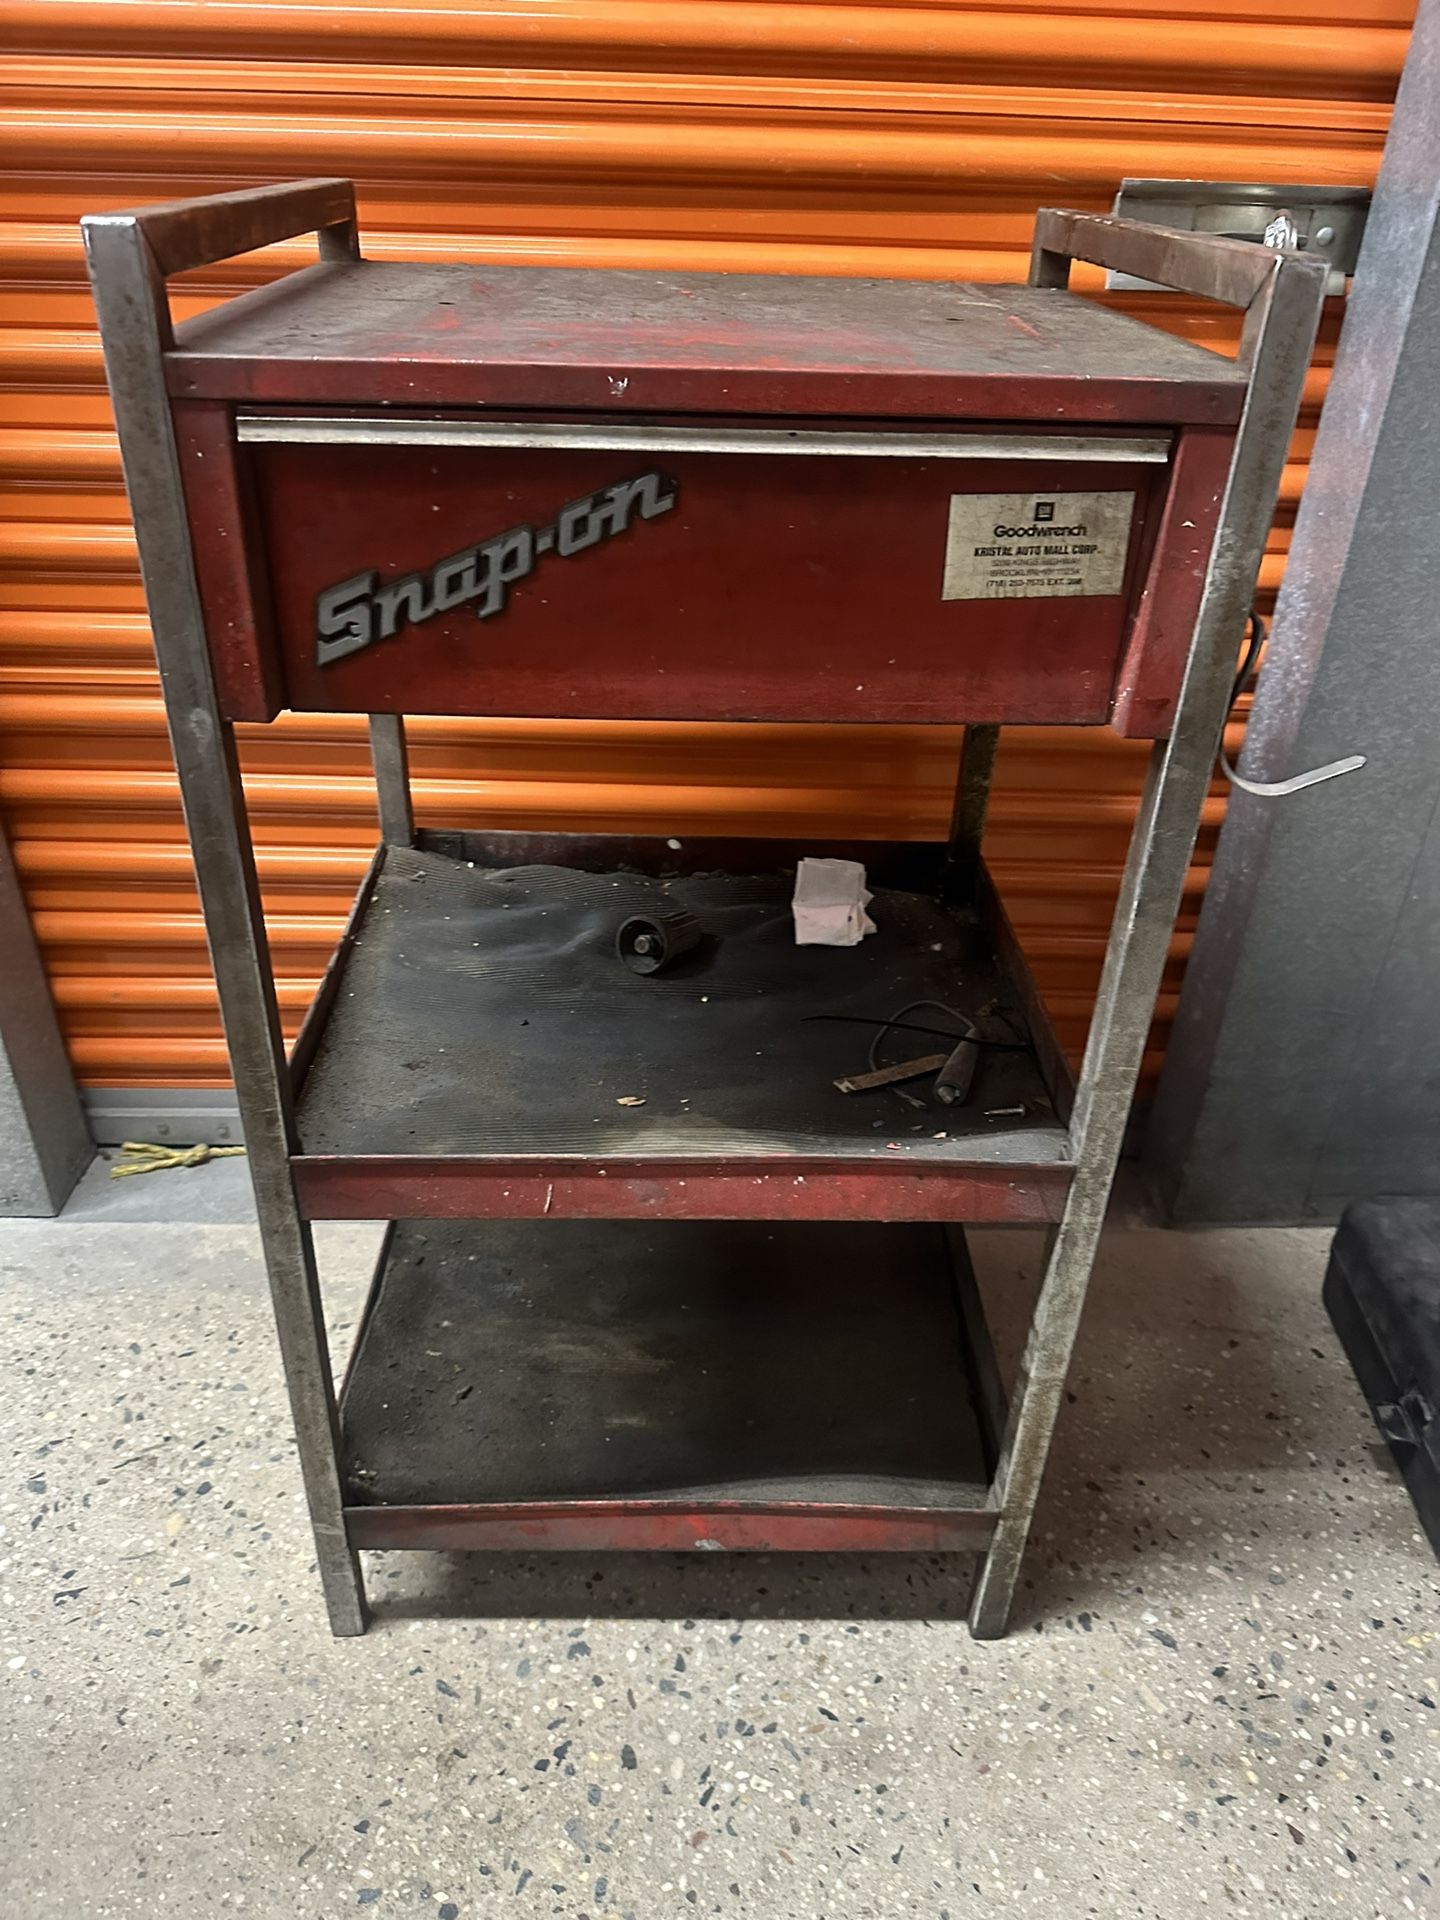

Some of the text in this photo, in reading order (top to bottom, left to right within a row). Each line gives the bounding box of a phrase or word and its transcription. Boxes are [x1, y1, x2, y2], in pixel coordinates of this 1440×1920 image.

[994, 524, 1087, 537] Goodwrench
[974, 544, 1102, 557] KRISTAL AUTO MALL CORP.
[316, 473, 678, 667] Snap-on
